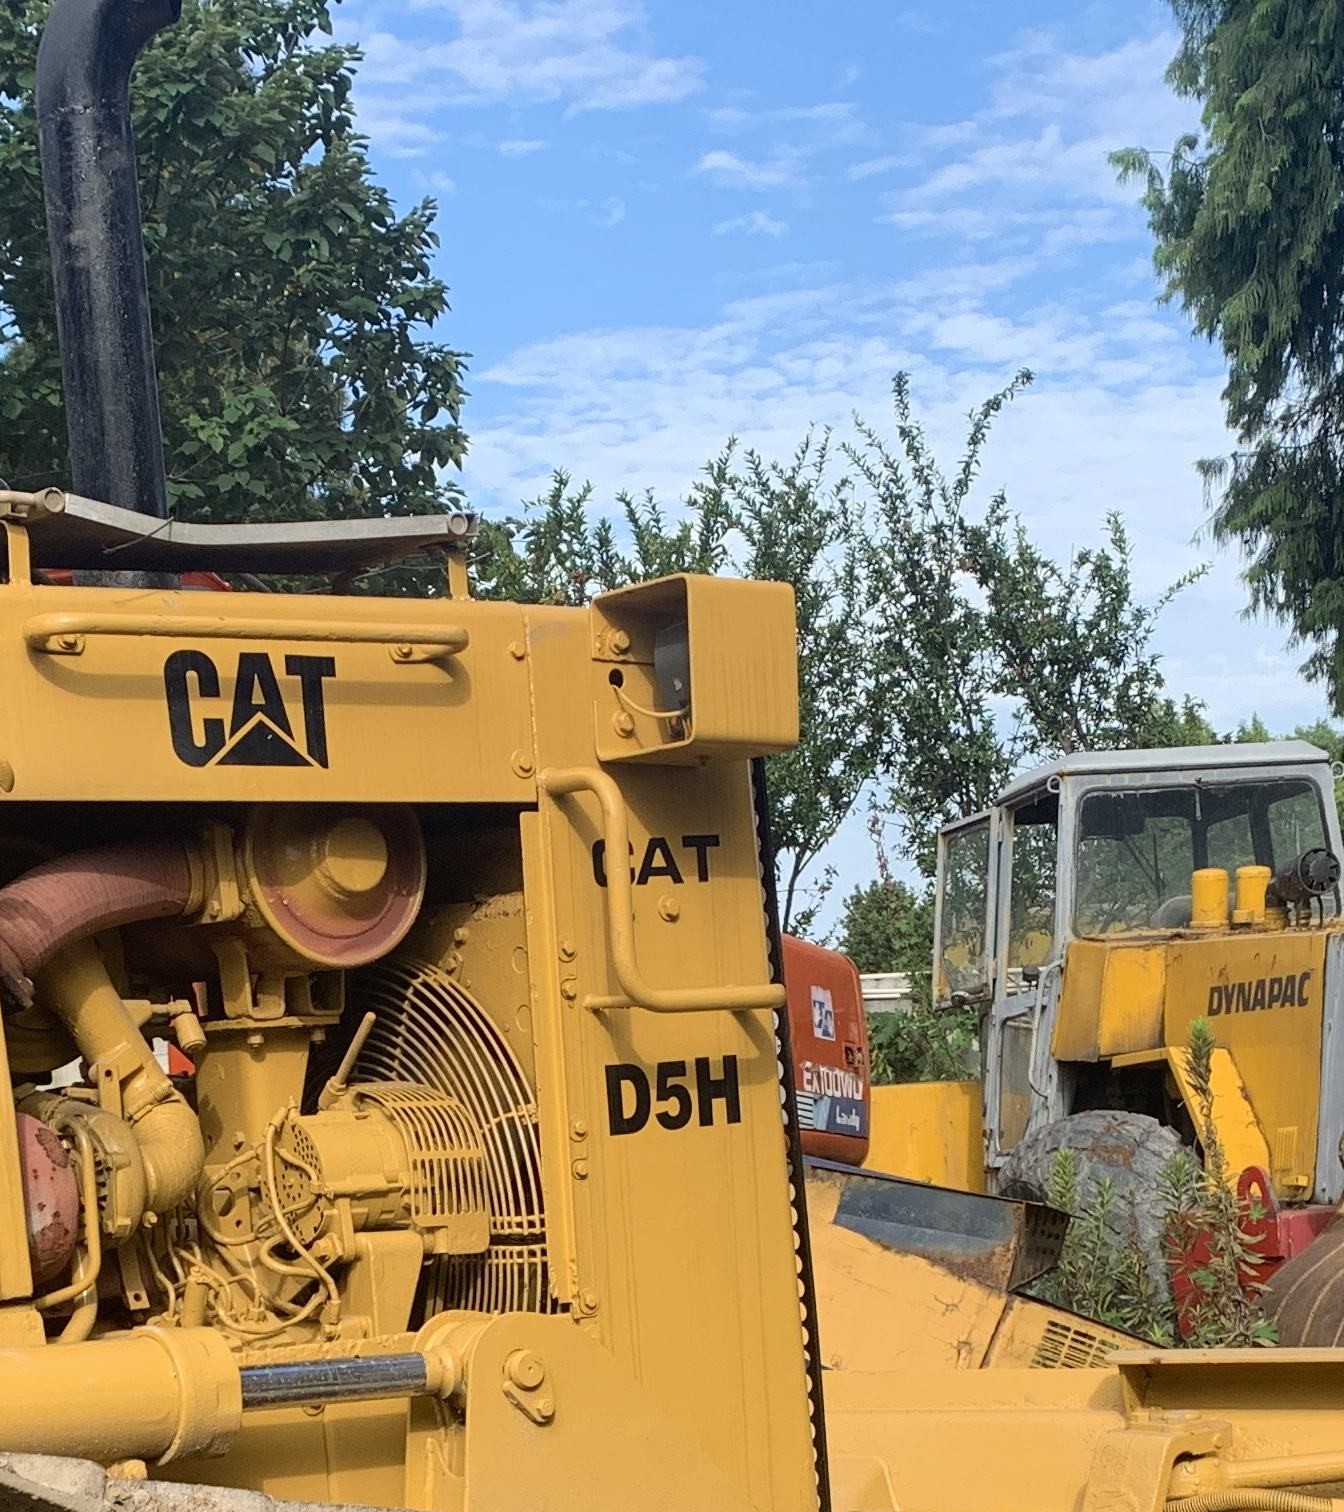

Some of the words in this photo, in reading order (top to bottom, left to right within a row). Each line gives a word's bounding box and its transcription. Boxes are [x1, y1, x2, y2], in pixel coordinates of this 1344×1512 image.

[163, 649, 337, 769] CAT
[1207, 971, 1311, 1017] DYNAPAC
[605, 1055, 741, 1136] D5H
